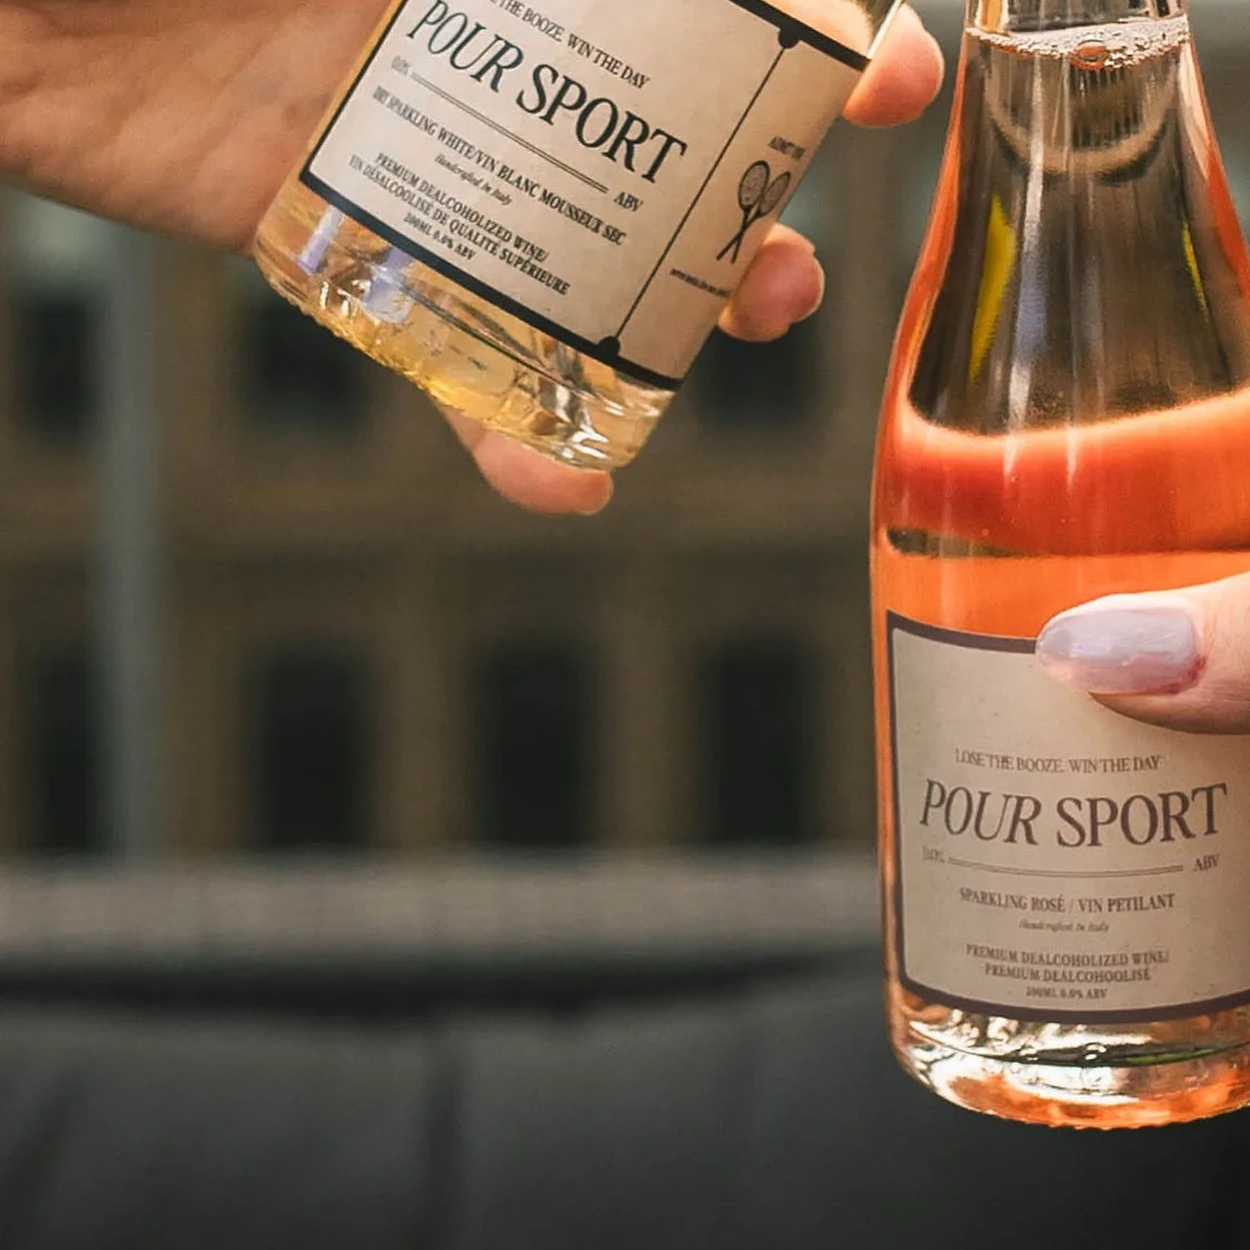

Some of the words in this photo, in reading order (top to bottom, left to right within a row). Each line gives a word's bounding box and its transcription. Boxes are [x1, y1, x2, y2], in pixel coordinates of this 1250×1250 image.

[567, 33, 595, 59] WIN
[593, 48, 623, 76] THE
[620, 65, 650, 89] DAY
[515, 63, 688, 184] SPORT
[387, 96, 439, 136] SPARKLING
[496, 164, 541, 198] BLANC
[538, 188, 604, 234] MOUSSEUX
[601, 224, 627, 246] SEC
[375, 153, 420, 188] PREMIUM
[417, 180, 513, 243] DEALCOHOLIZED
[513, 235, 547, 263] WINE/
[613, 191, 644, 212] ABV
[348, 154, 364, 172] VIN
[431, 208, 450, 226] DE
[498, 247, 571, 296] SUPÉRIEURE
[453, 243, 476, 260] ABV
[955, 747, 986, 768] LOSE
[985, 753, 1015, 771] THE
[1067, 758, 1098, 774] WIN
[1098, 757, 1131, 774] THE
[1132, 754, 1161, 772] DAY
[919, 778, 1042, 846] POUR
[1056, 782, 1227, 848] SPORT
[959, 887, 1028, 911] SPARKLING
[1030, 893, 1066, 913] ROSÉ
[1077, 898, 1103, 914] VIN
[1107, 893, 1175, 913] PETILANT
[966, 943, 1019, 963] PREMIUM
[1021, 950, 1129, 967] DEALCOHOLIZED
[985, 962, 1041, 981] PREMIUM
